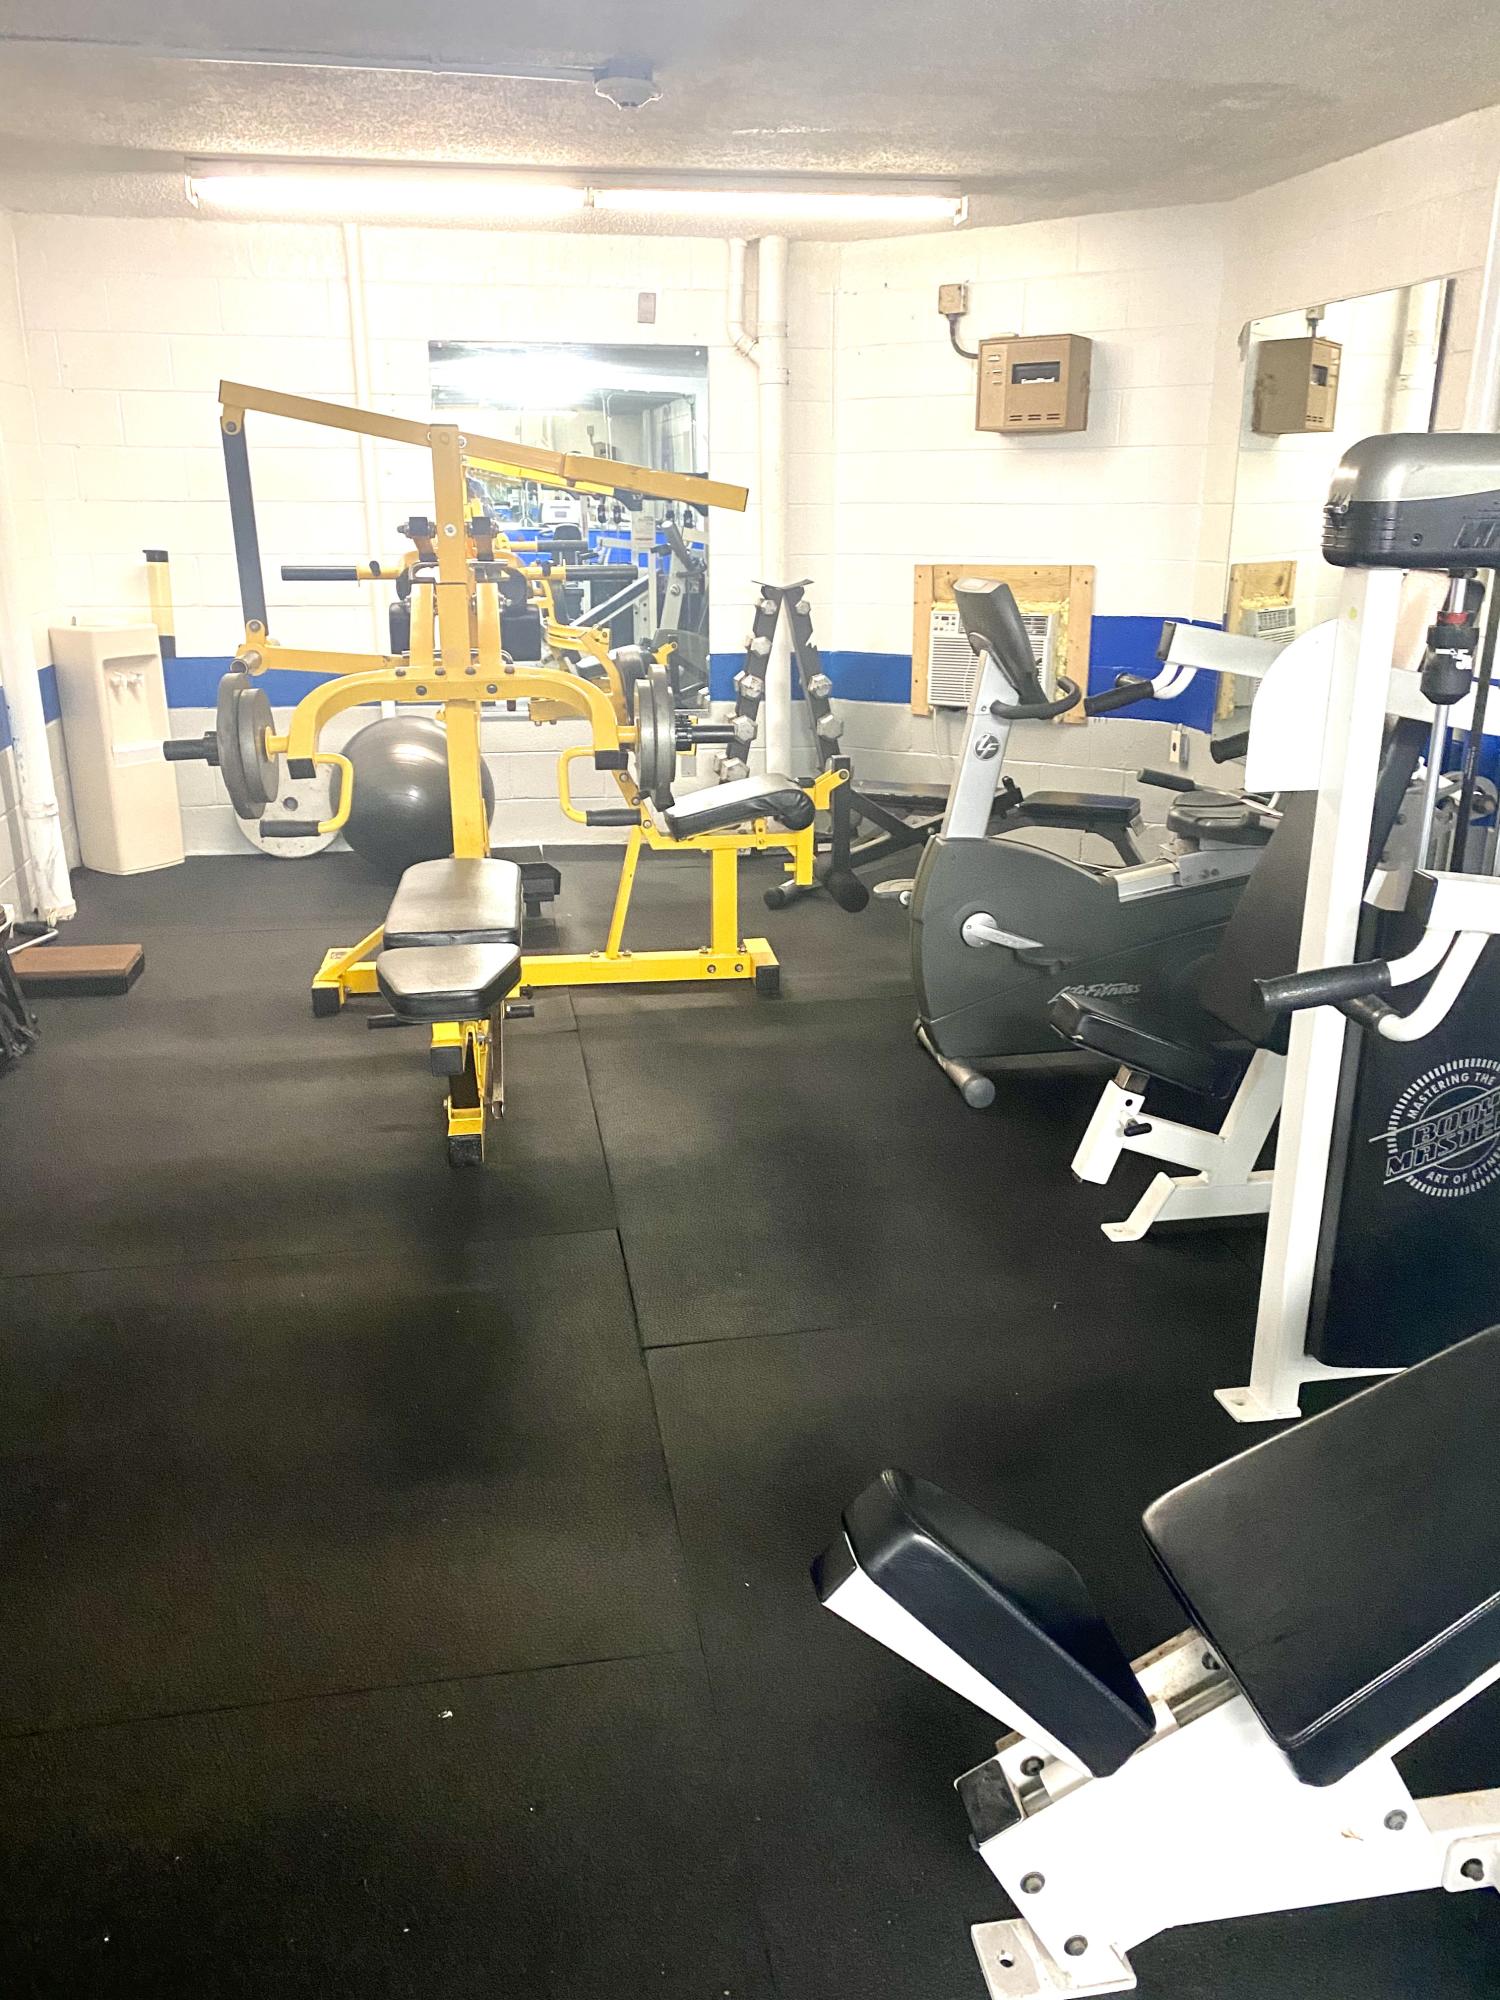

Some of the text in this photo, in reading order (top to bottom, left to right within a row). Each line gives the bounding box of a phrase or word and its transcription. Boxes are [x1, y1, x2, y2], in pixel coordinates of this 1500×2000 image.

[1406, 1072, 1497, 1120] MASTERING THE
[1385, 1110, 1500, 1177] MASTE
[1425, 1146, 1500, 1185] ART OF FITNE
